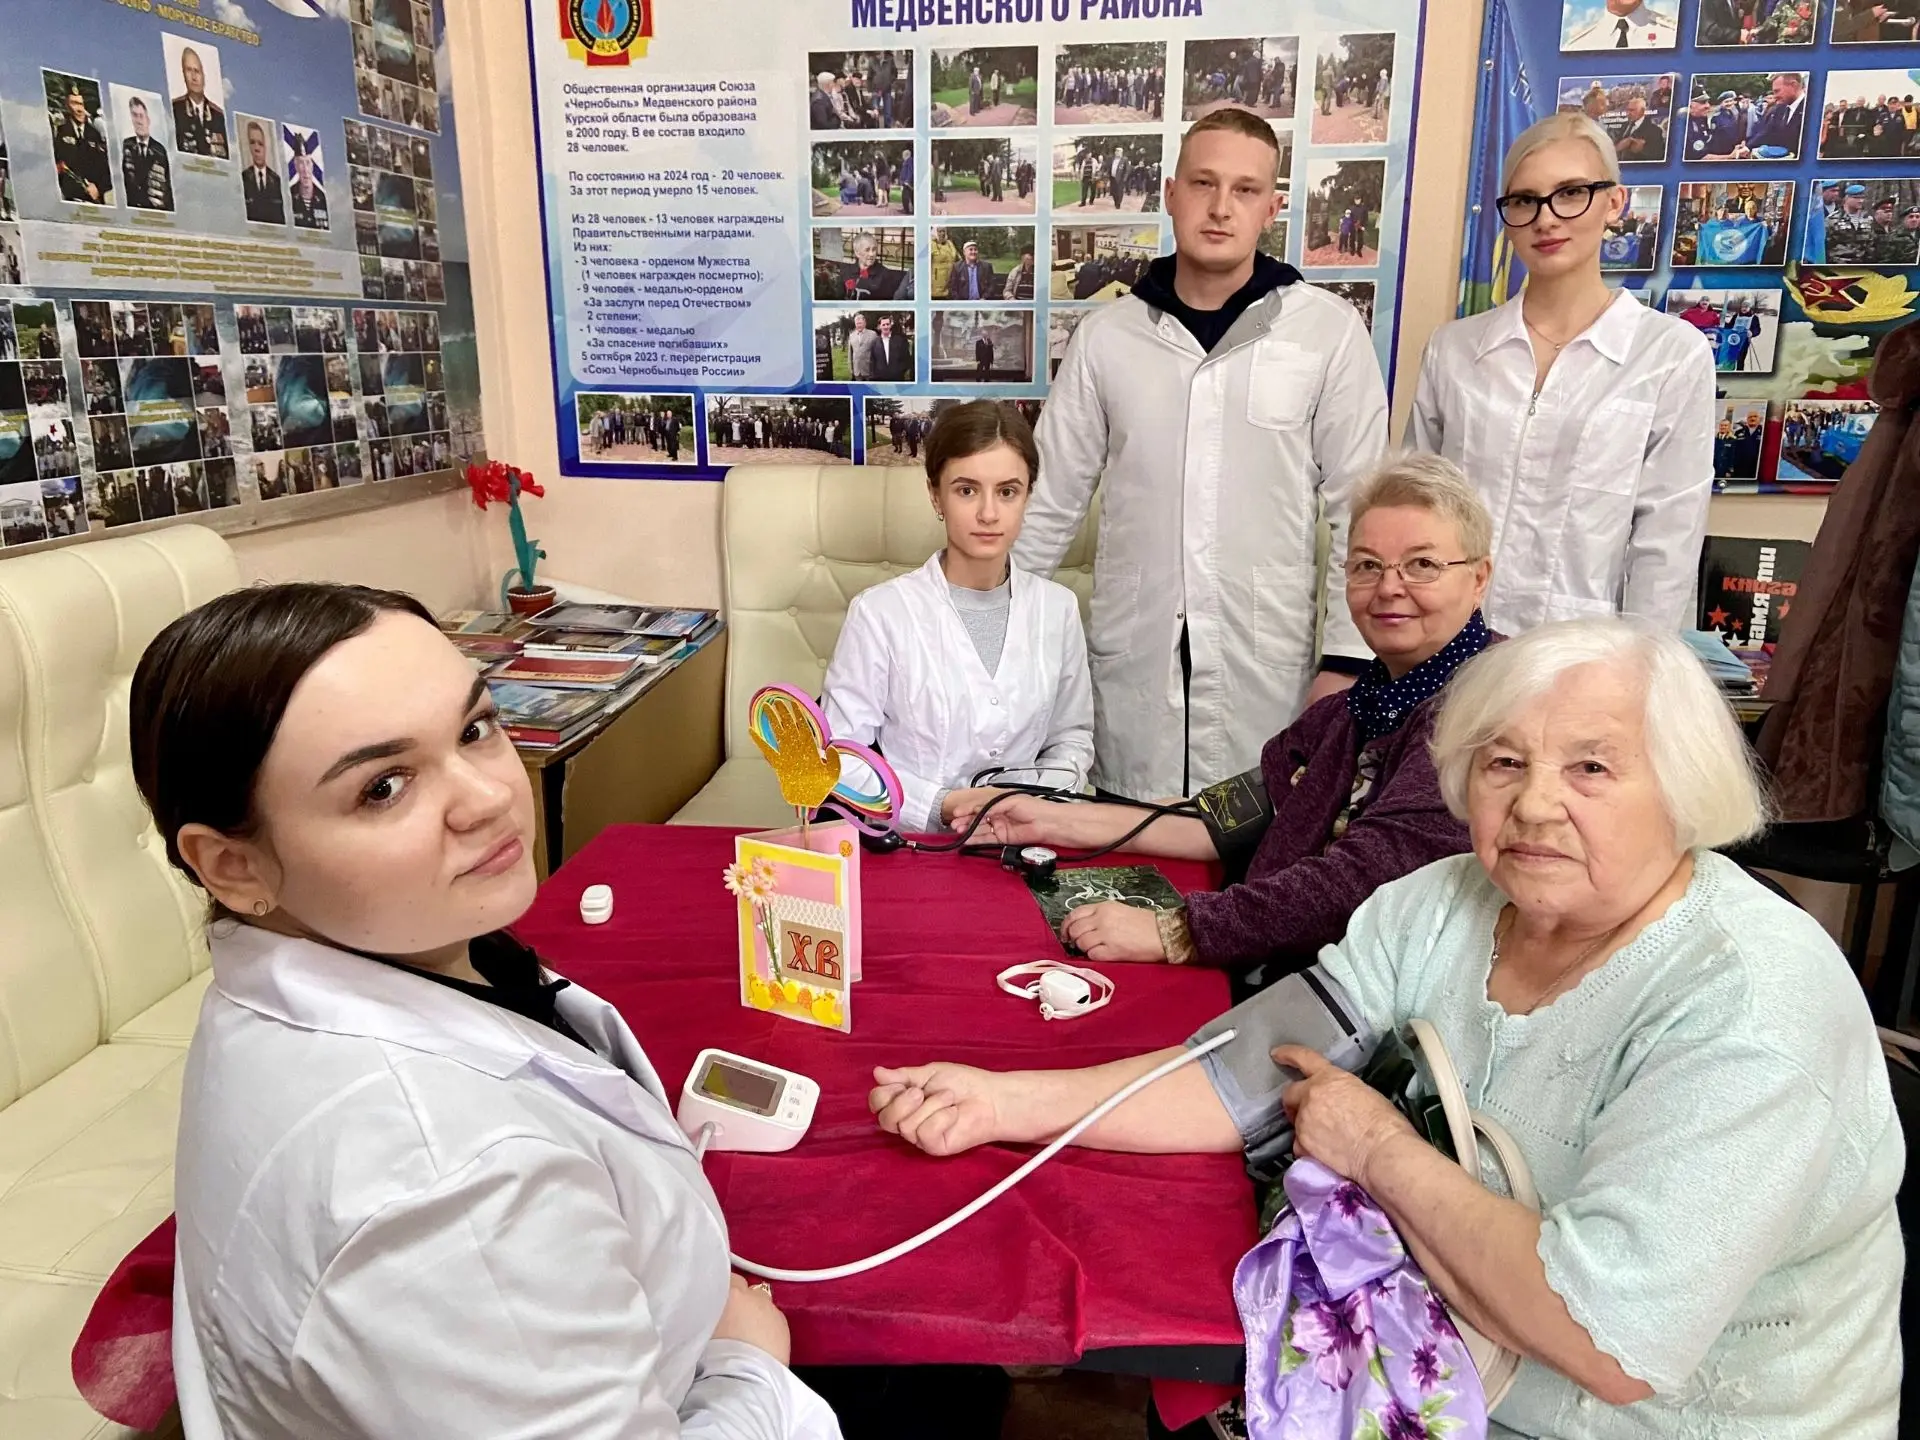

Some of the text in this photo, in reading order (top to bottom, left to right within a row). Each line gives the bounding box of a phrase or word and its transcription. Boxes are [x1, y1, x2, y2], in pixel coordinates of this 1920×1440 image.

[563, 81, 755, 96] Общественная организация Союза
[565, 96, 756, 110] «Чернобыль» Медвенского района
[565, 111, 756, 125] Курской области была образована
[576, 128, 599, 137] 2000
[603, 129, 630, 140] году.
[632, 127, 639, 137] В
[643, 129, 655, 137] ее
[699, 128, 745, 137] входило
[567, 142, 579, 152] 28
[569, 171, 583, 181] По
[587, 173, 645, 181] состоянию
[664, 171, 688, 180] 2024
[691, 173, 709, 181] год
[722, 170, 733, 180] 20
[737, 172, 784, 180] человек.
[570, 185, 582, 195] За
[611, 188, 650, 197] период
[653, 187, 693, 197] умерло
[697, 185, 708, 195] 15
[711, 187, 758, 195] человек.
[572, 214, 585, 223] Из
[588, 214, 599, 223] 28
[603, 216, 646, 224] человек
[657, 214, 667, 223] 13
[718, 216, 784, 225] награждены
[573, 228, 754, 239] Правительственными наградами.
[574, 242, 586, 252] Из
[582, 256, 587, 265] 3
[590, 258, 639, 266] человека
[649, 259, 694, 268] орденом
[698, 256, 750, 268] Мужества
[582, 270, 590, 283] (1
[640, 272, 695, 281] награжден
[699, 271, 763, 282] посмертно);
[583, 284, 589, 293] 9
[644, 286, 743, 296] медалью-орденом
[584, 297, 751, 309] «За заслуги перед Отечеством»
[587, 311, 641, 321] 2 степени;
[587, 324, 590, 333] 1
[647, 327, 695, 335] медалью
[587, 338, 604, 347] «За
[659, 339, 728, 349] погибавших»
[582, 351, 761, 364] 5 октября 2023 г. перерегистрация
[583, 364, 745, 376] «Союз Чернобыльцев России»
[787, 931, 841, 980] ХВ
